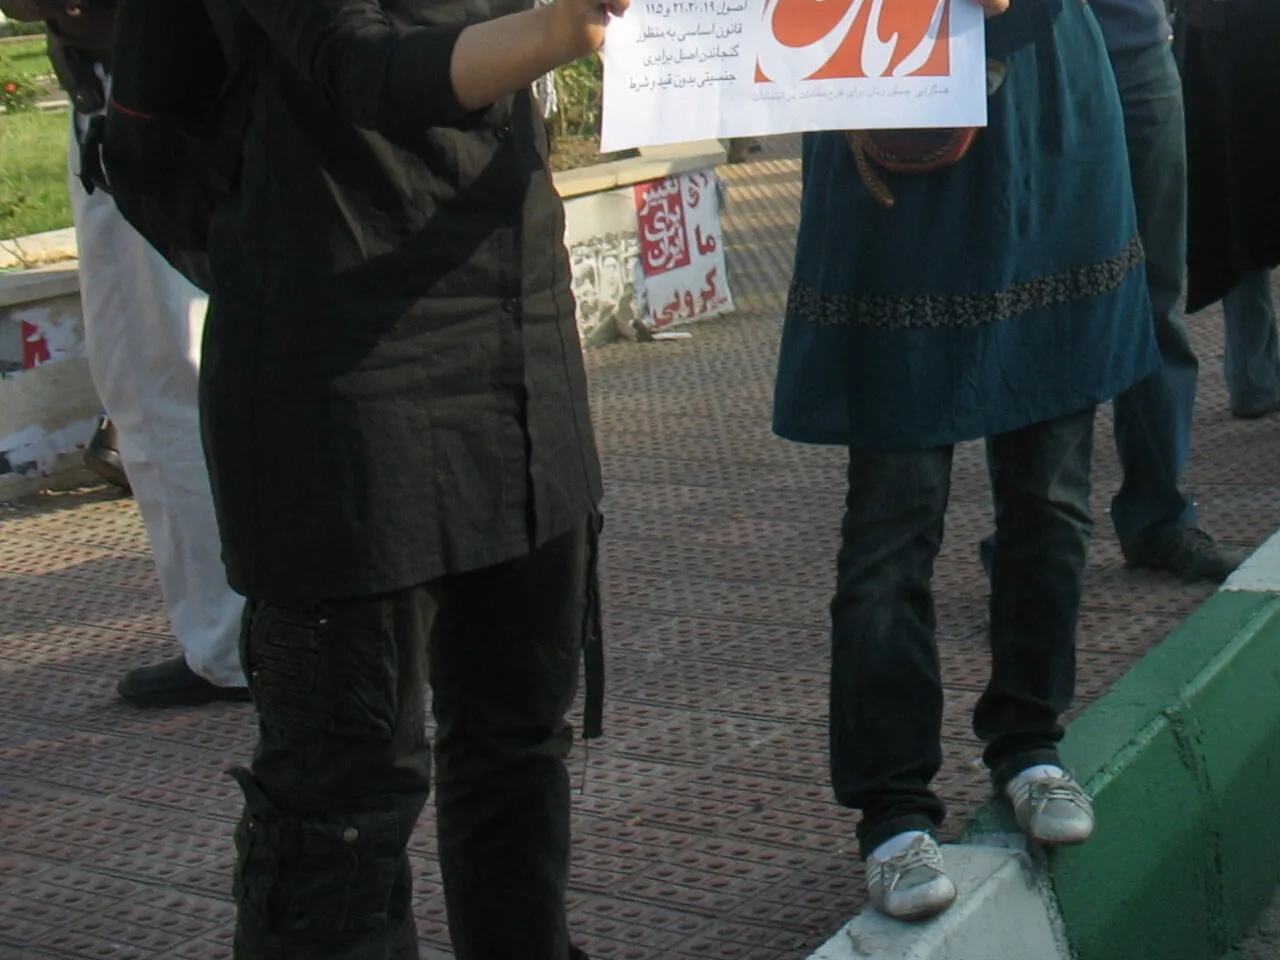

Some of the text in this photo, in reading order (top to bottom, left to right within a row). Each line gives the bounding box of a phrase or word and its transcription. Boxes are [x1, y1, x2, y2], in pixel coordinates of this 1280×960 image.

[717, 0, 748, 16] اصول
[636, 24, 665, 43] منظور
[677, 24, 716, 42] اساسی
[715, 23, 743, 38] قانون
[643, 44, 740, 66] گنجاندن اصل برابری
[628, 77, 650, 92] شرط
[657, 73, 673, 89] قید
[672, 75, 696, 88] بدون
[697, 70, 736, 87] جنسیتی
[694, 224, 717, 256] ما
[652, 267, 717, 327] کروبی
